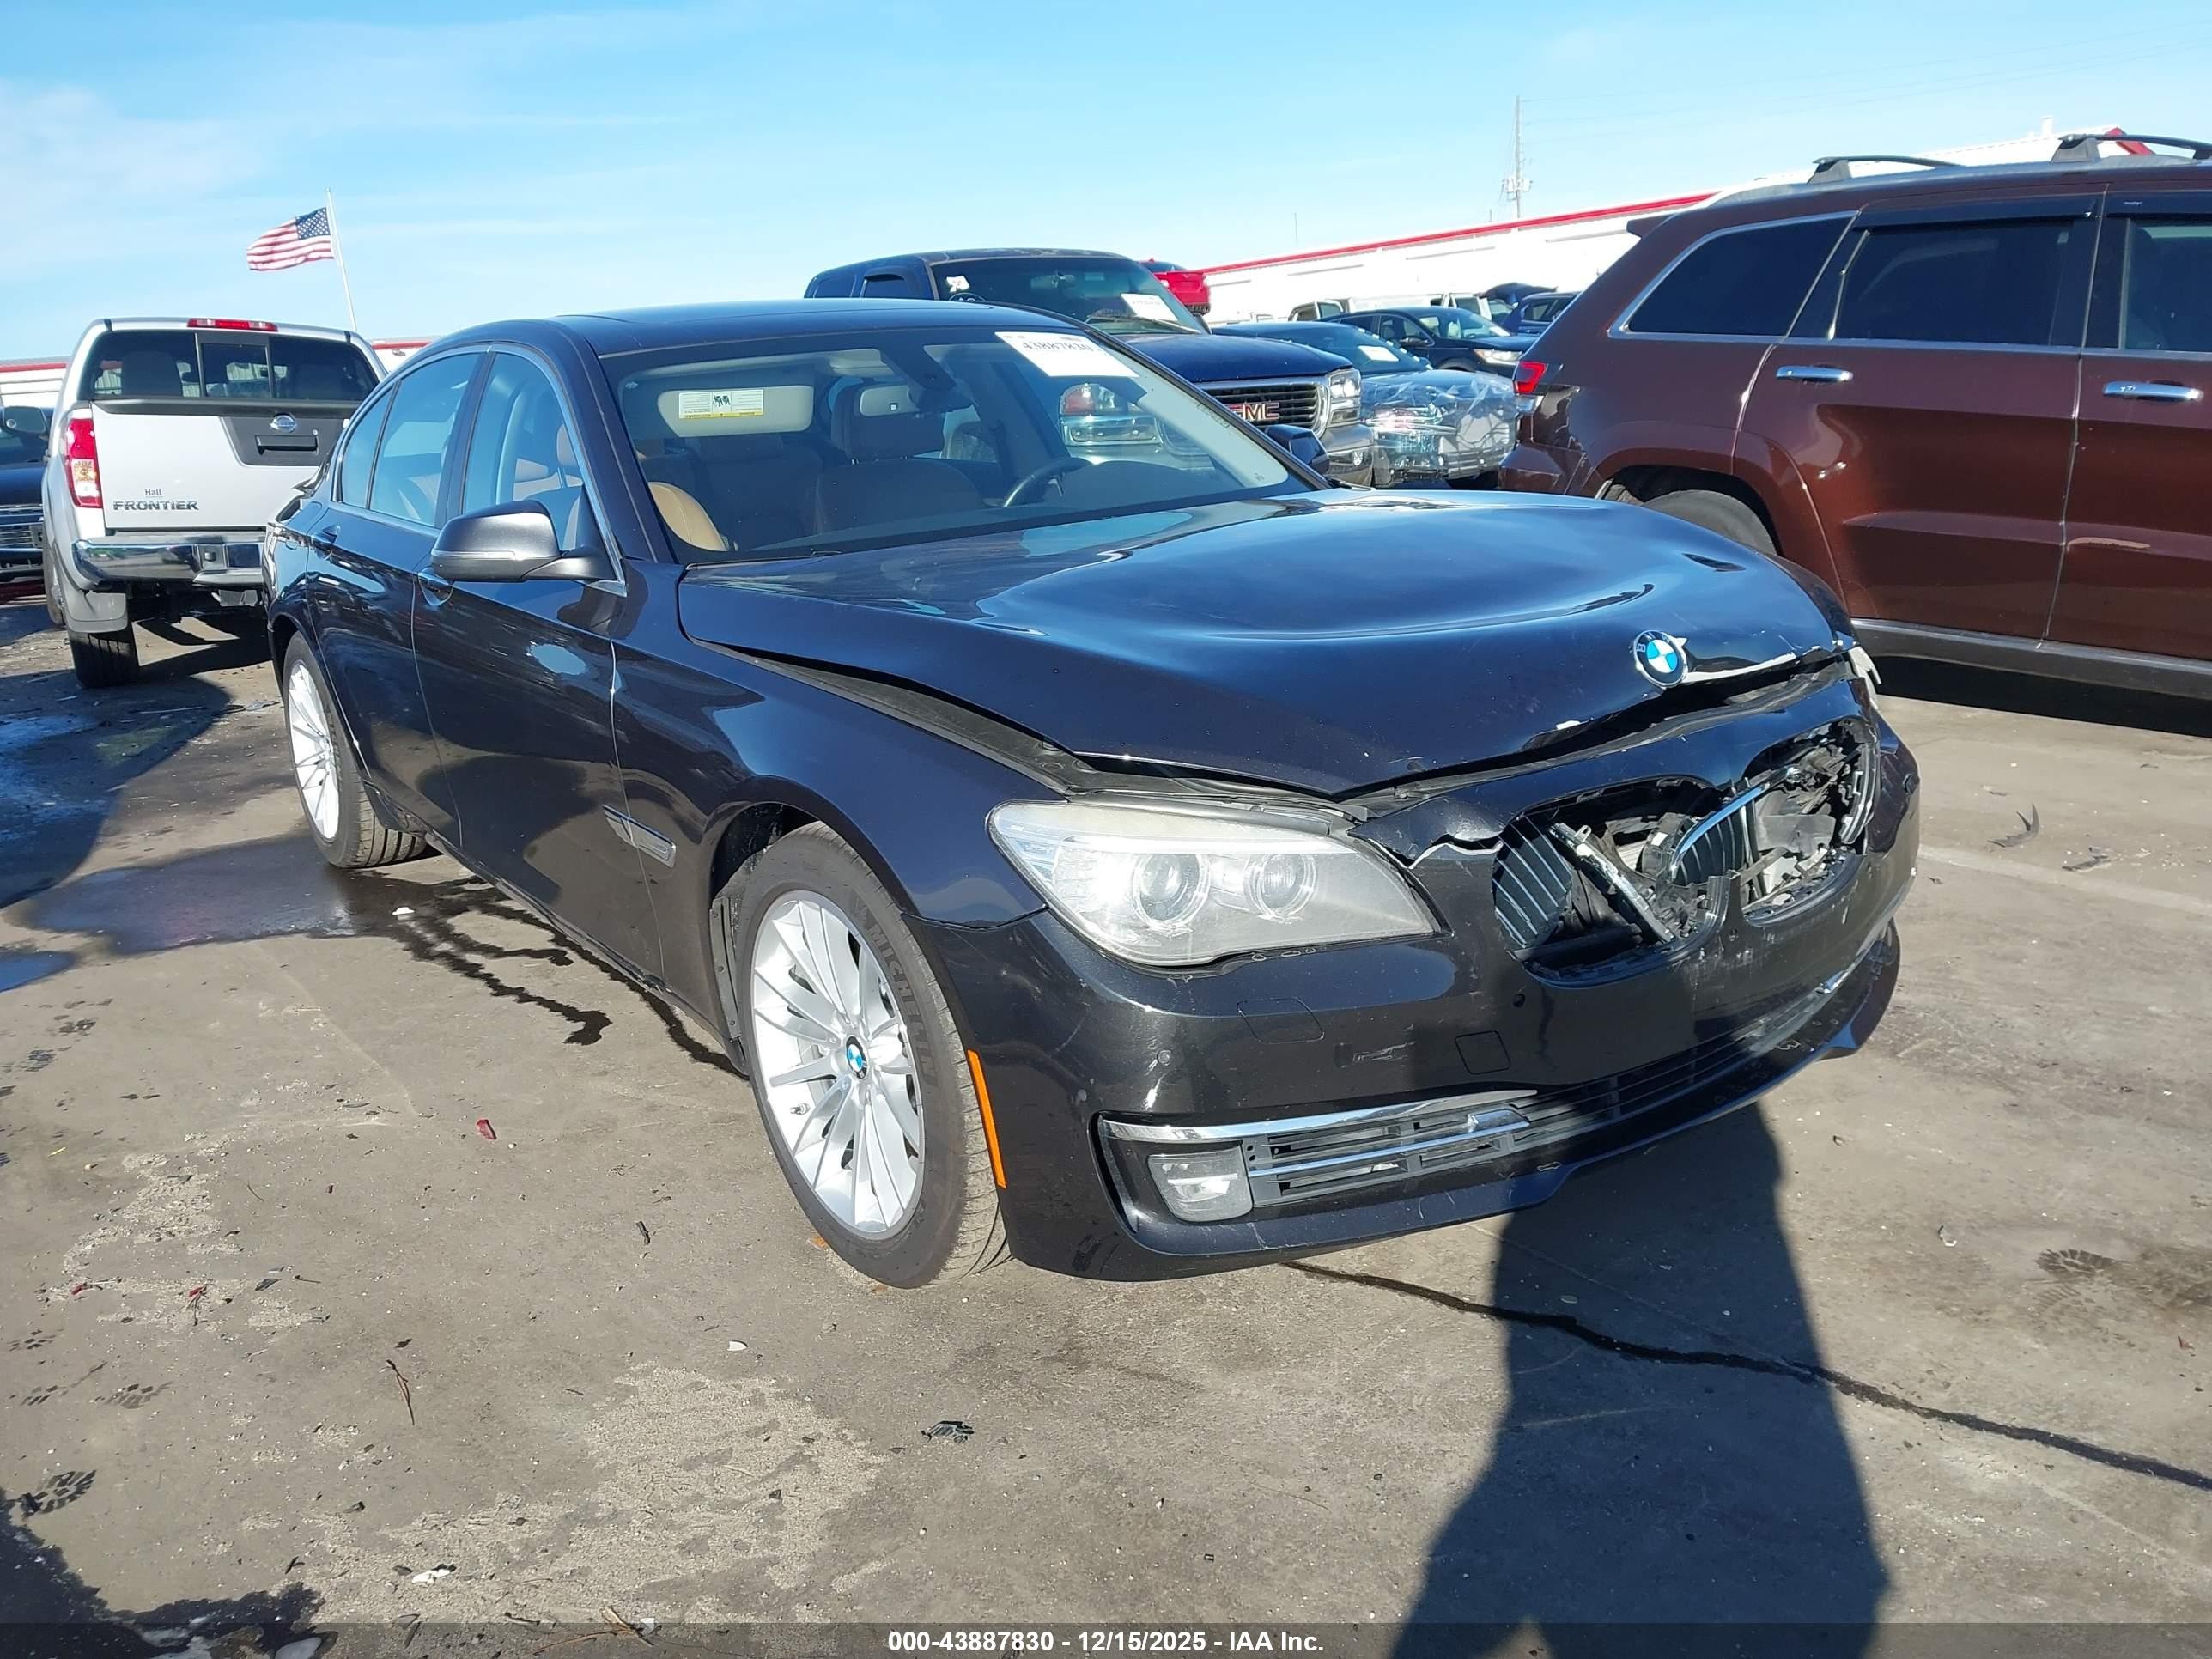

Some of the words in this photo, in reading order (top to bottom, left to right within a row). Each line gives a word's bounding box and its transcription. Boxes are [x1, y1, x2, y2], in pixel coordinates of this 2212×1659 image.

[144, 488, 162, 496] Hall
[112, 500, 199, 511] FRONTIER
[867, 923, 937, 1079] MICHELIN
